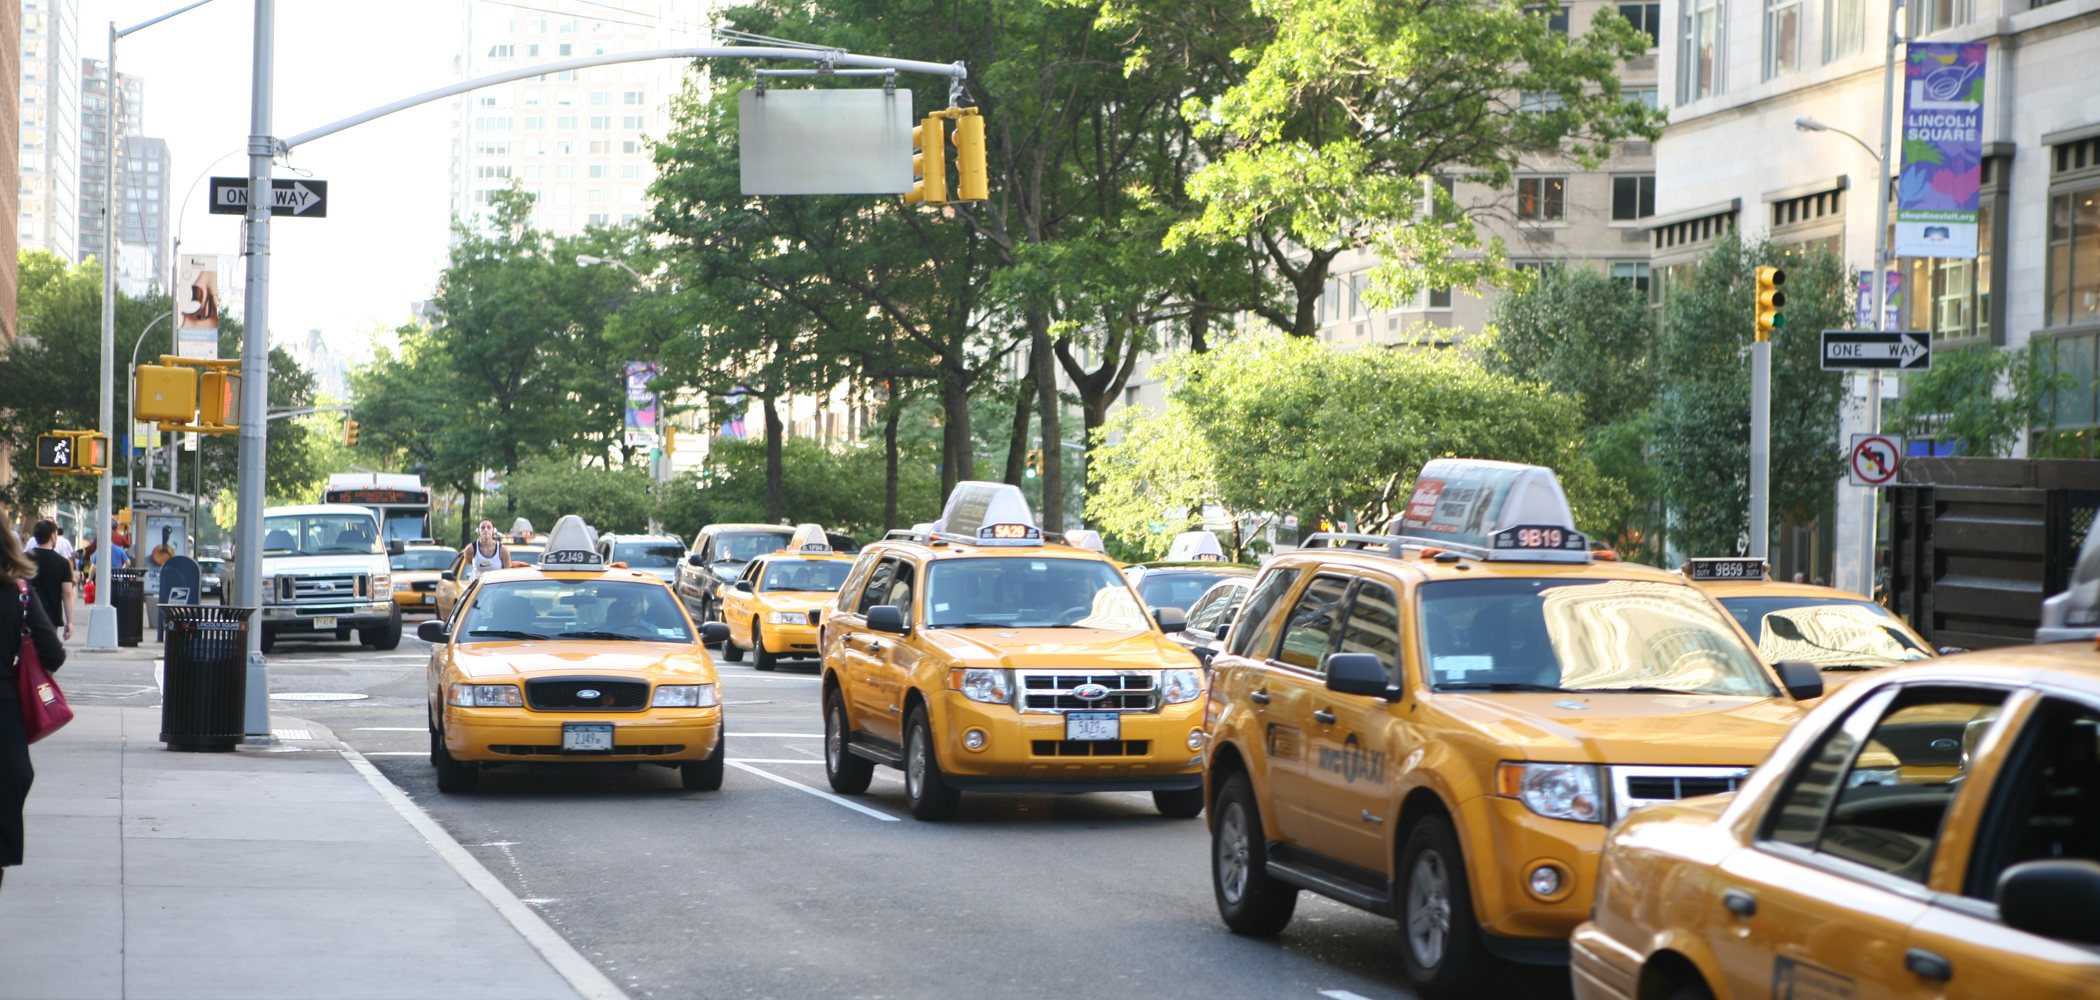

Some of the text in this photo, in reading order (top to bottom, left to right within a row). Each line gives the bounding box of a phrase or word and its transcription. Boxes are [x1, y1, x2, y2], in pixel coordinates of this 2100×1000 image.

[1909, 114, 1976, 128] LINCOLN
[1908, 128, 1975, 141] SQUARE
[226, 188, 309, 206] ON WAY
[1900, 211, 1976, 222] shopdinevisit.org
[1832, 344, 1919, 356] ONE WAY
[995, 524, 1026, 538] 5A29
[1518, 528, 1562, 547] 9B19
[559, 552, 584, 562] 2J49
[1715, 562, 1743, 576] 9B59
